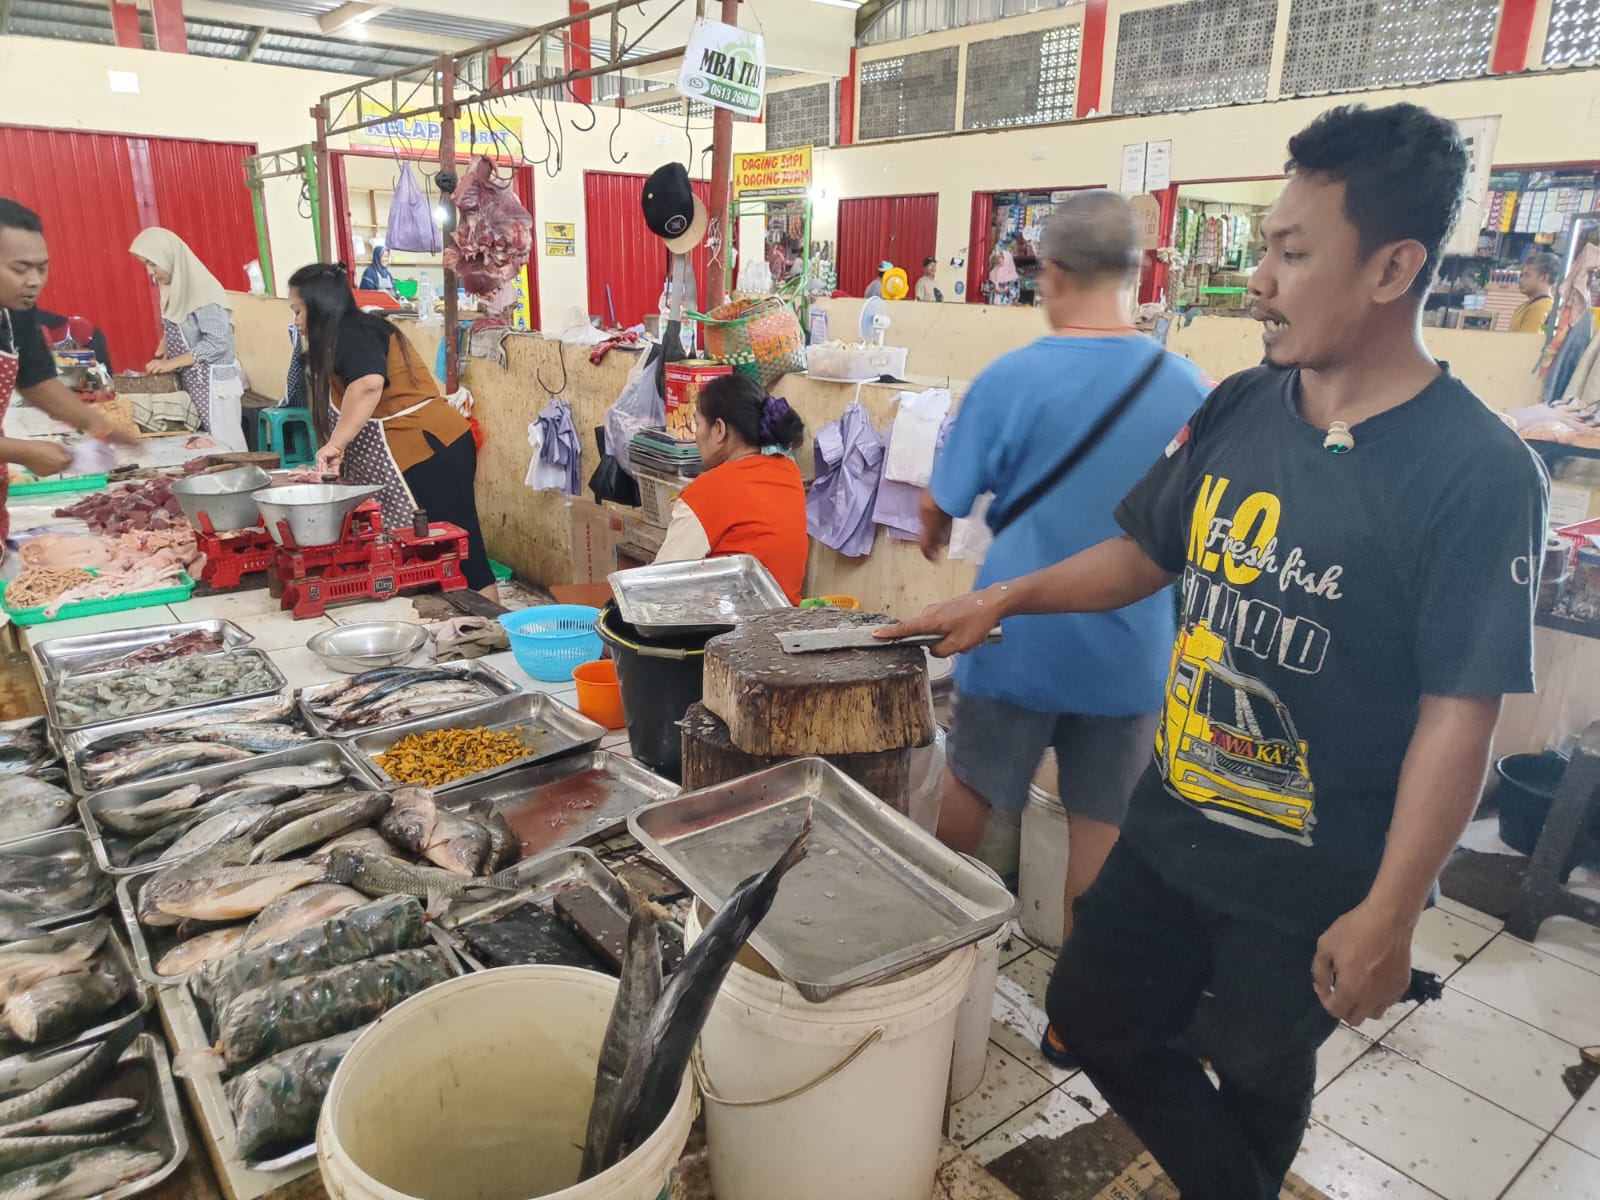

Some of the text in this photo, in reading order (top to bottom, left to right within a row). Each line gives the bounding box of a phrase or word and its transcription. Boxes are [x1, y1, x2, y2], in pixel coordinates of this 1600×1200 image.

[699, 48, 736, 81] MBA
[365, 115, 442, 140] KELAP
[742, 154, 803, 171] DAGING SAPI
[744, 173, 780, 186] DAGING
[1204, 517, 1344, 600] Fresh fish
